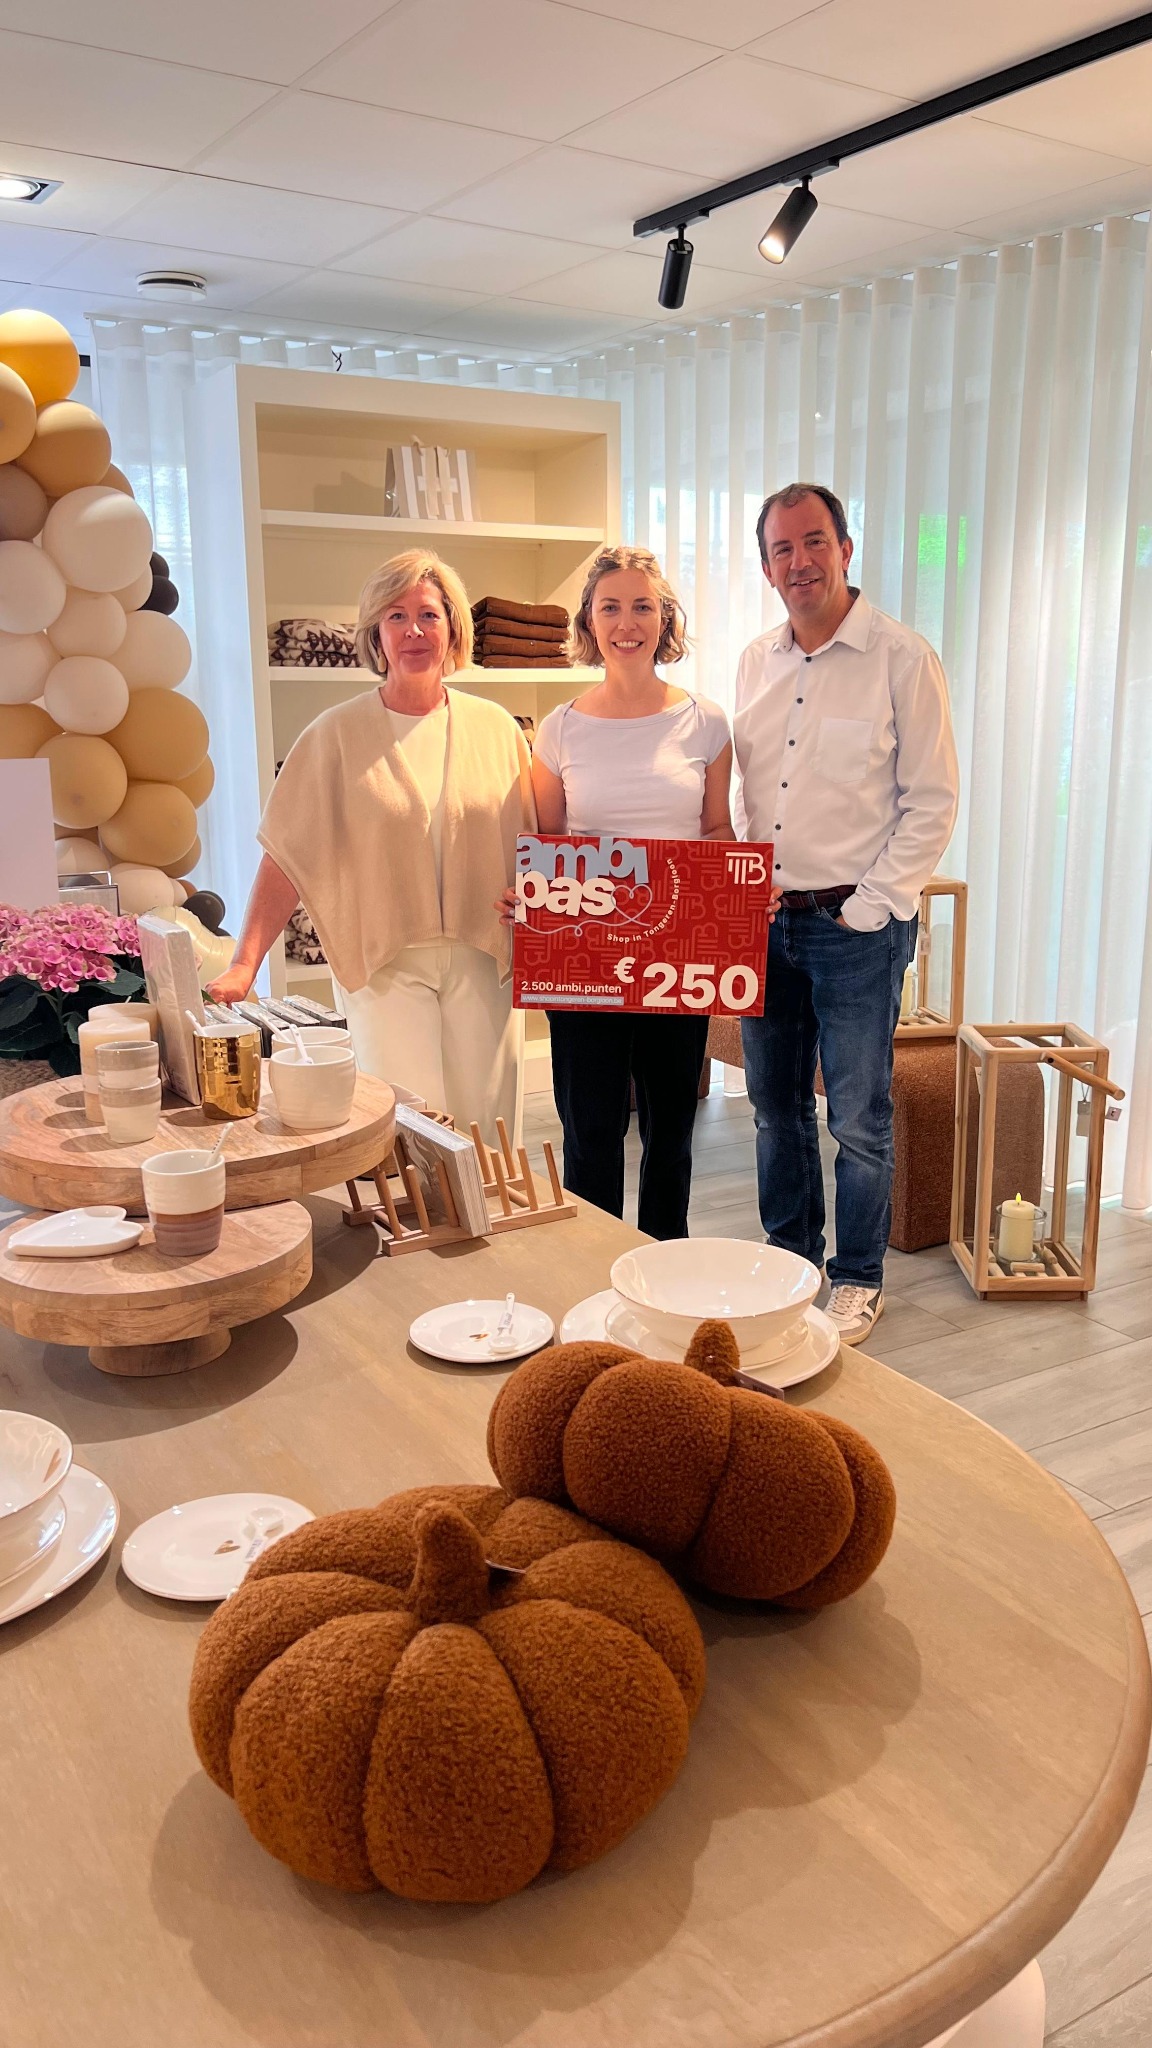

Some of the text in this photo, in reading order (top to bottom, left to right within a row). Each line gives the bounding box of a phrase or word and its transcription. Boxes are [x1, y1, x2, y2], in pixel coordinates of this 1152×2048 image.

[516, 836, 649, 884] ambi
[515, 871, 616, 923] pas
[606, 933, 630, 944] Shop
[632, 934, 642, 943] in
[521, 981, 622, 995] 2.500 ambi.punten
[613, 956, 759, 1010] € 250
